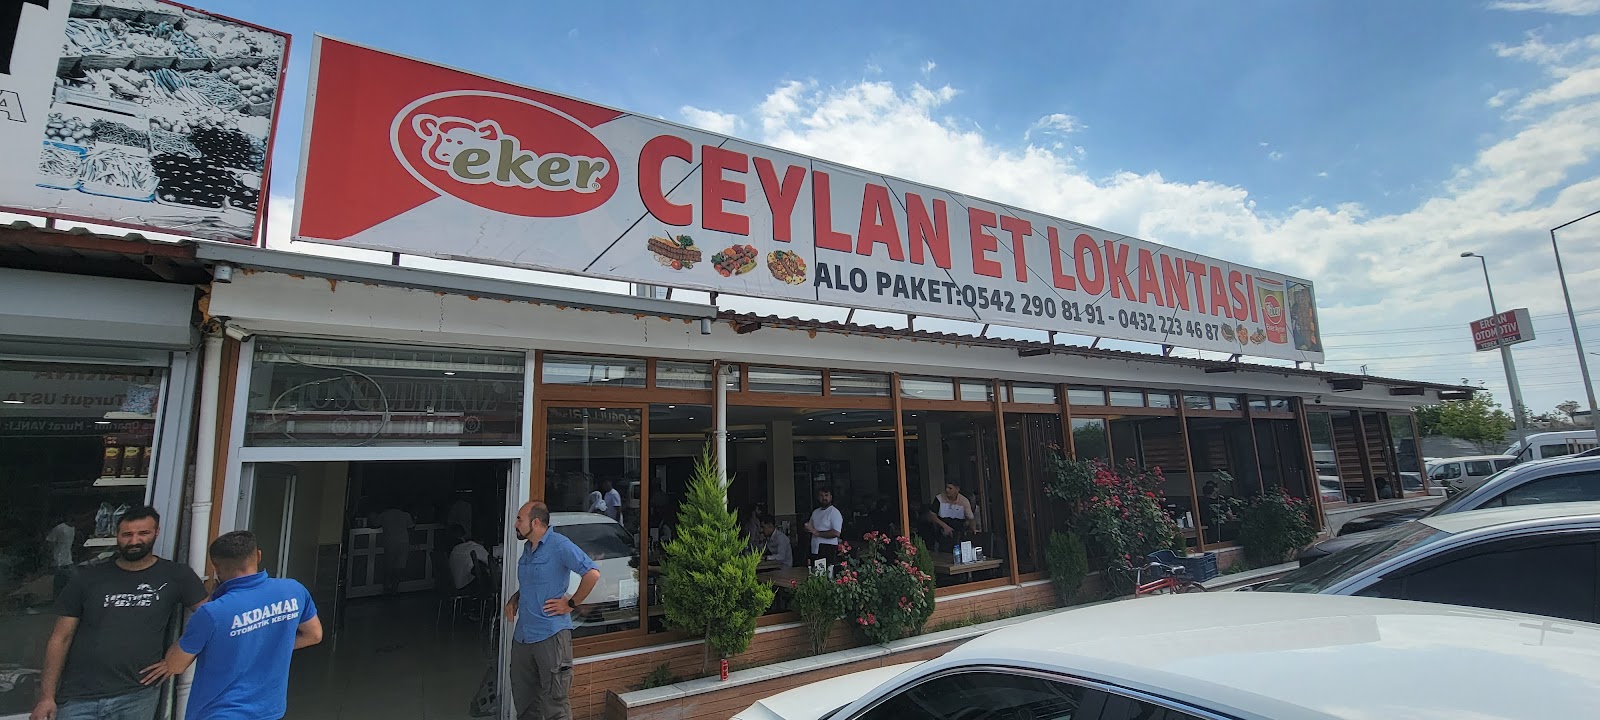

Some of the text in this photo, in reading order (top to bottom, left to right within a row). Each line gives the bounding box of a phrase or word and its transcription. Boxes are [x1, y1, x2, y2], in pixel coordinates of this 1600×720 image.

[452, 138, 605, 190] eker
[637, 134, 1259, 323] CEYLAN ET LOKANTASI
[814, 262, 868, 293] ALO
[1021, 294, 1057, 319] 290
[1062, 300, 1082, 322] 81
[1085, 303, 1105, 325] 91
[1119, 309, 1157, 333] 0432
[1159, 316, 1183, 336] 223
[1186, 320, 1203, 339] 46
[1205, 323, 1219, 341] 87
[229, 612, 300, 637] OTOMATİK KEPENK
[231, 598, 299, 630] AKDAMAR
